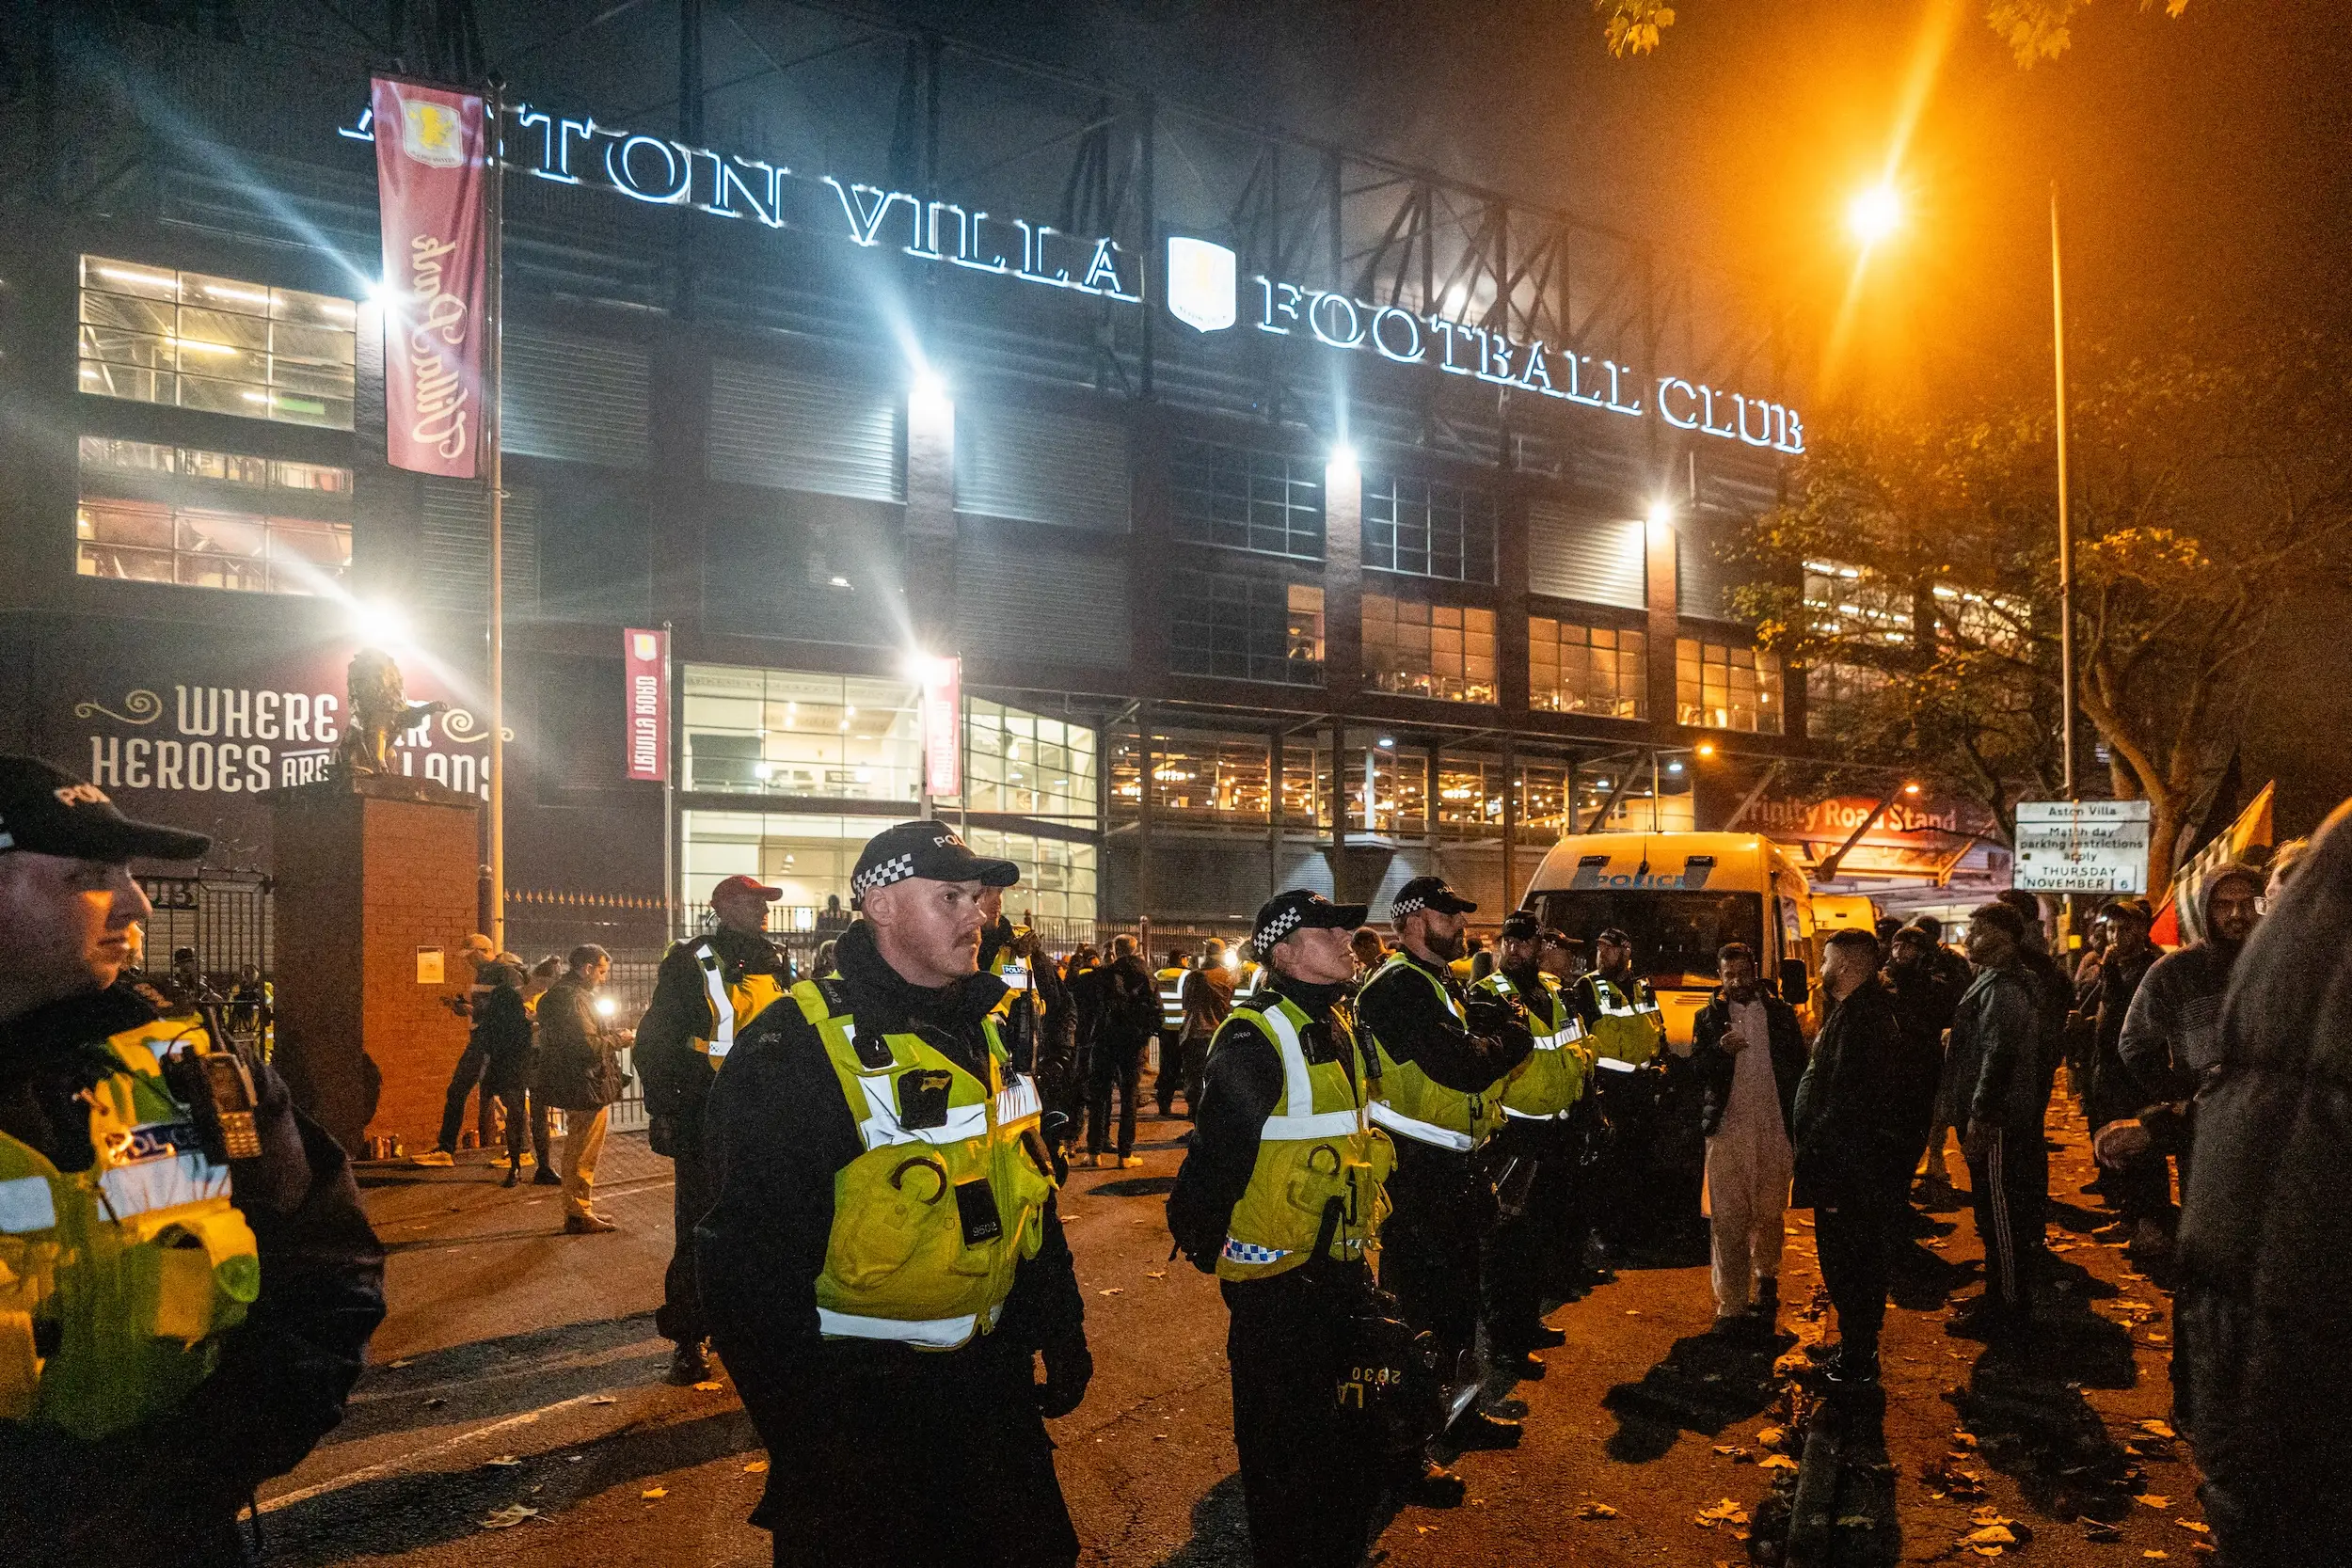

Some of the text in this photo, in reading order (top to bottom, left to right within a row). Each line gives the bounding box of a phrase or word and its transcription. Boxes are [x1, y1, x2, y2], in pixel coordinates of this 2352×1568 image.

[338, 102, 1805, 455] TON VILLA FOOTBALL CLUB
[175, 685, 339, 743] WHERE
[89, 734, 272, 795] HEROES
[2090, 805, 2117, 816] Villa
[1889, 802, 1956, 832] Stand
[2049, 827, 2114, 838] Math day
[2021, 840, 2066, 850] parking
[2042, 866, 2117, 877] THURSDAY
[2026, 878, 2128, 889] NOVEMBER 6
